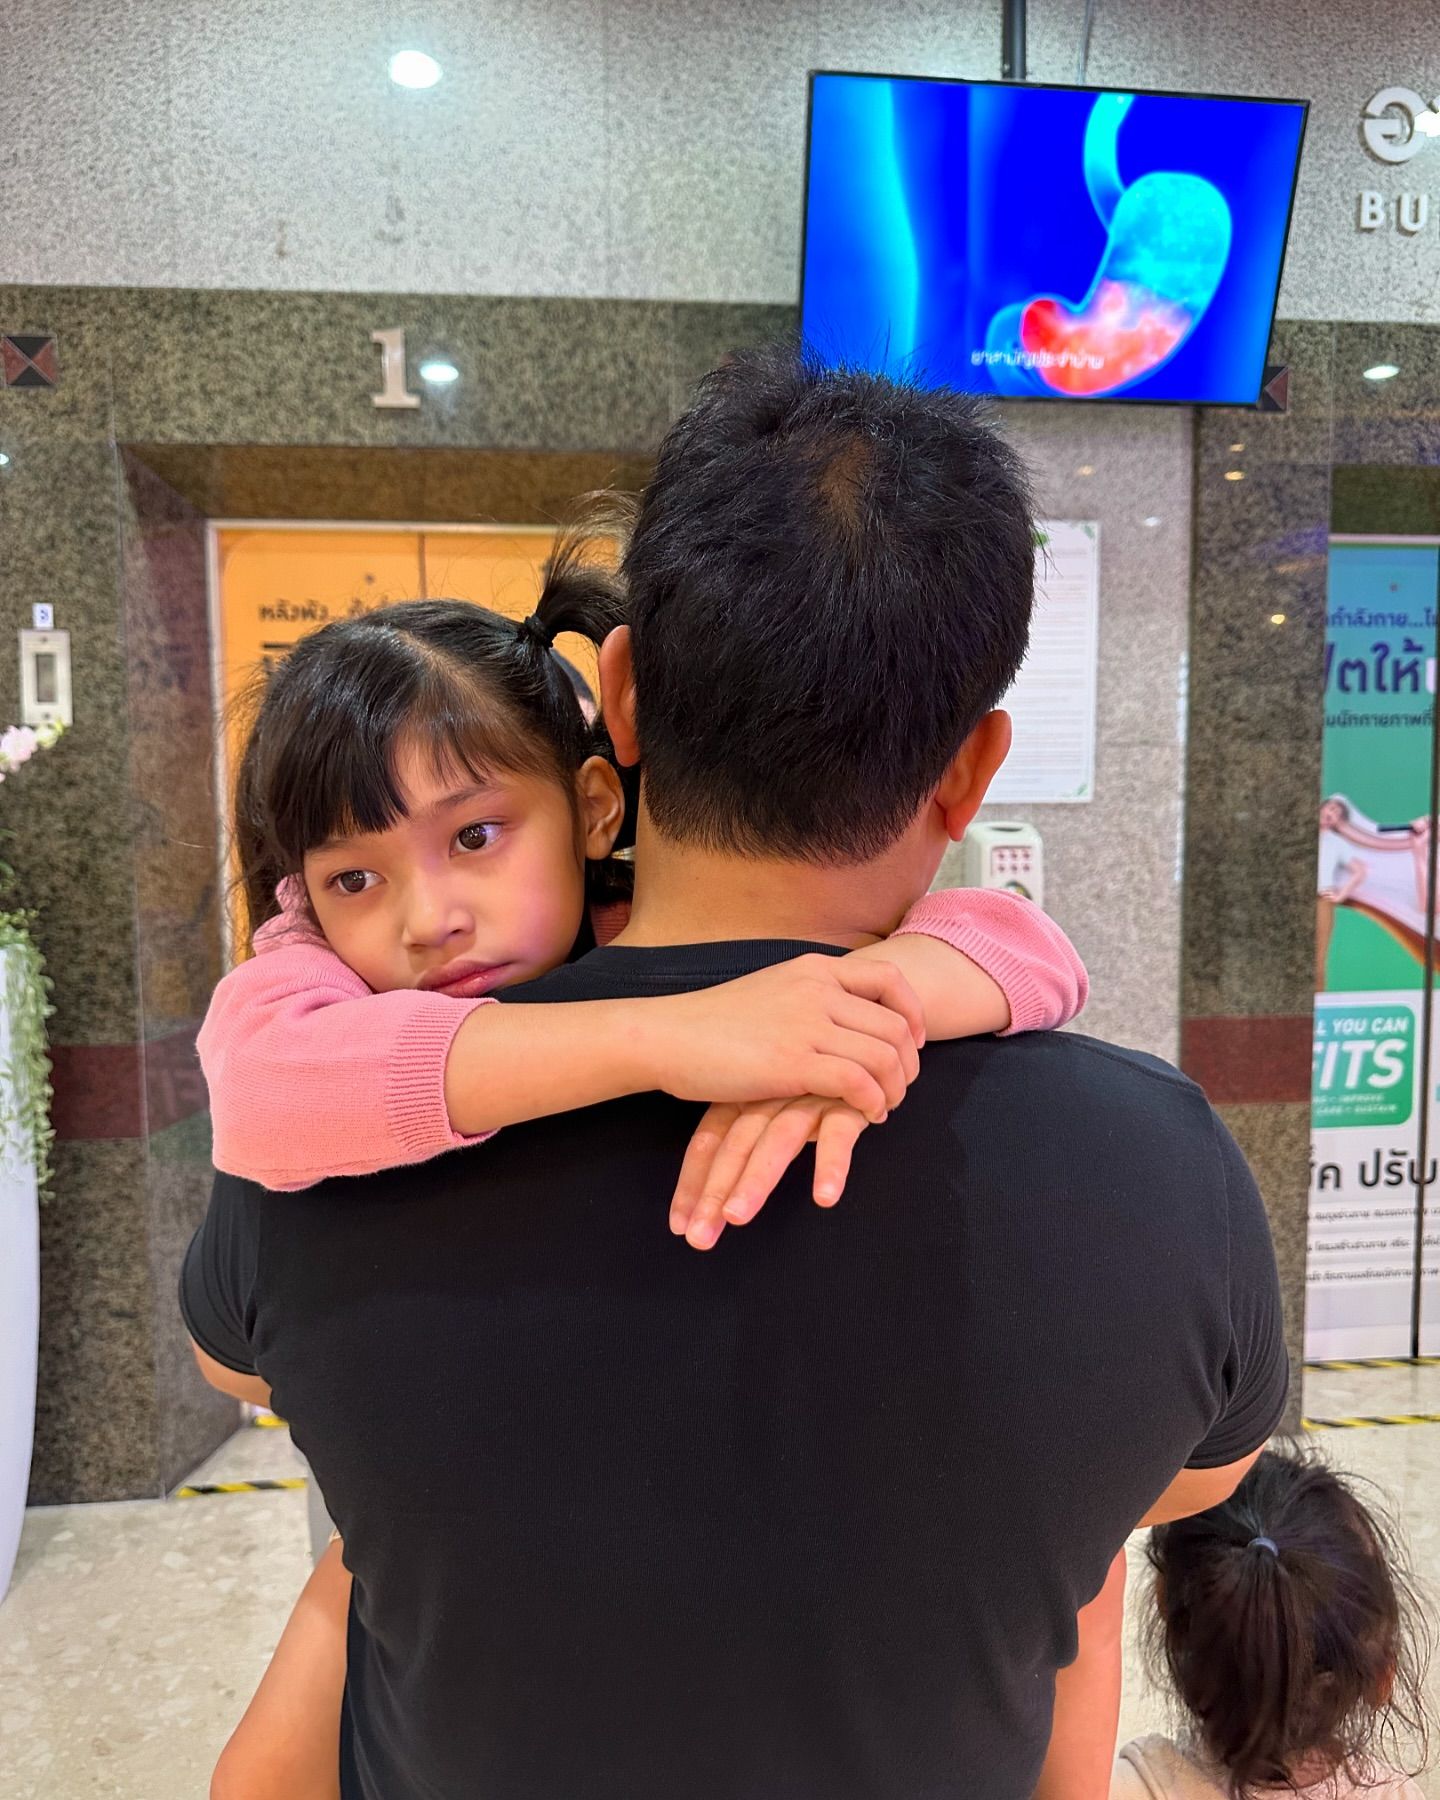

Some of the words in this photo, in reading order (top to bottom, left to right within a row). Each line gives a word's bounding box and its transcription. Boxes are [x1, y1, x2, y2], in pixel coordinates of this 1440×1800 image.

[1360, 190, 1428, 232] BU
[370, 327, 420, 408] 1
[1314, 1019, 1327, 1036] L
[1332, 1018, 1367, 1035] YOU
[1371, 1015, 1410, 1034] CAN
